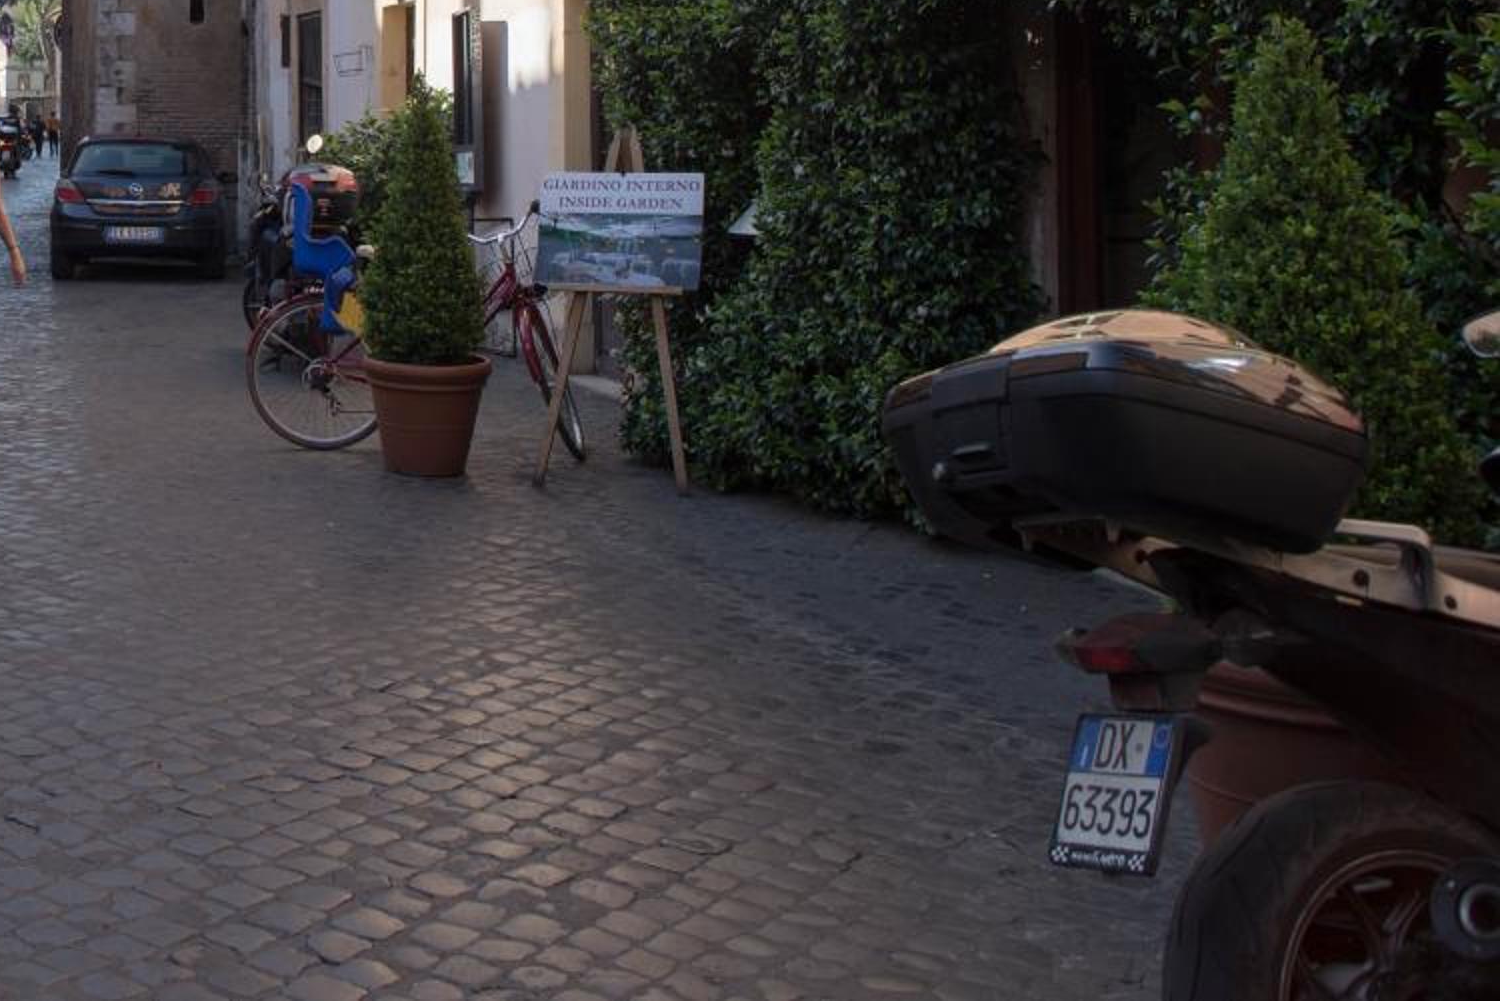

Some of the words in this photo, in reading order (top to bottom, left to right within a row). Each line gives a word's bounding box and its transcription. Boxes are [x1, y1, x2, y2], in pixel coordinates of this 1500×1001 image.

[543, 178, 621, 192] GIARDINO
[626, 179, 700, 192] INTERNO
[558, 196, 612, 209] INSIDE
[616, 197, 683, 210] GARDEN
[1093, 722, 1136, 770] DX
[1063, 783, 1155, 839] 63393
